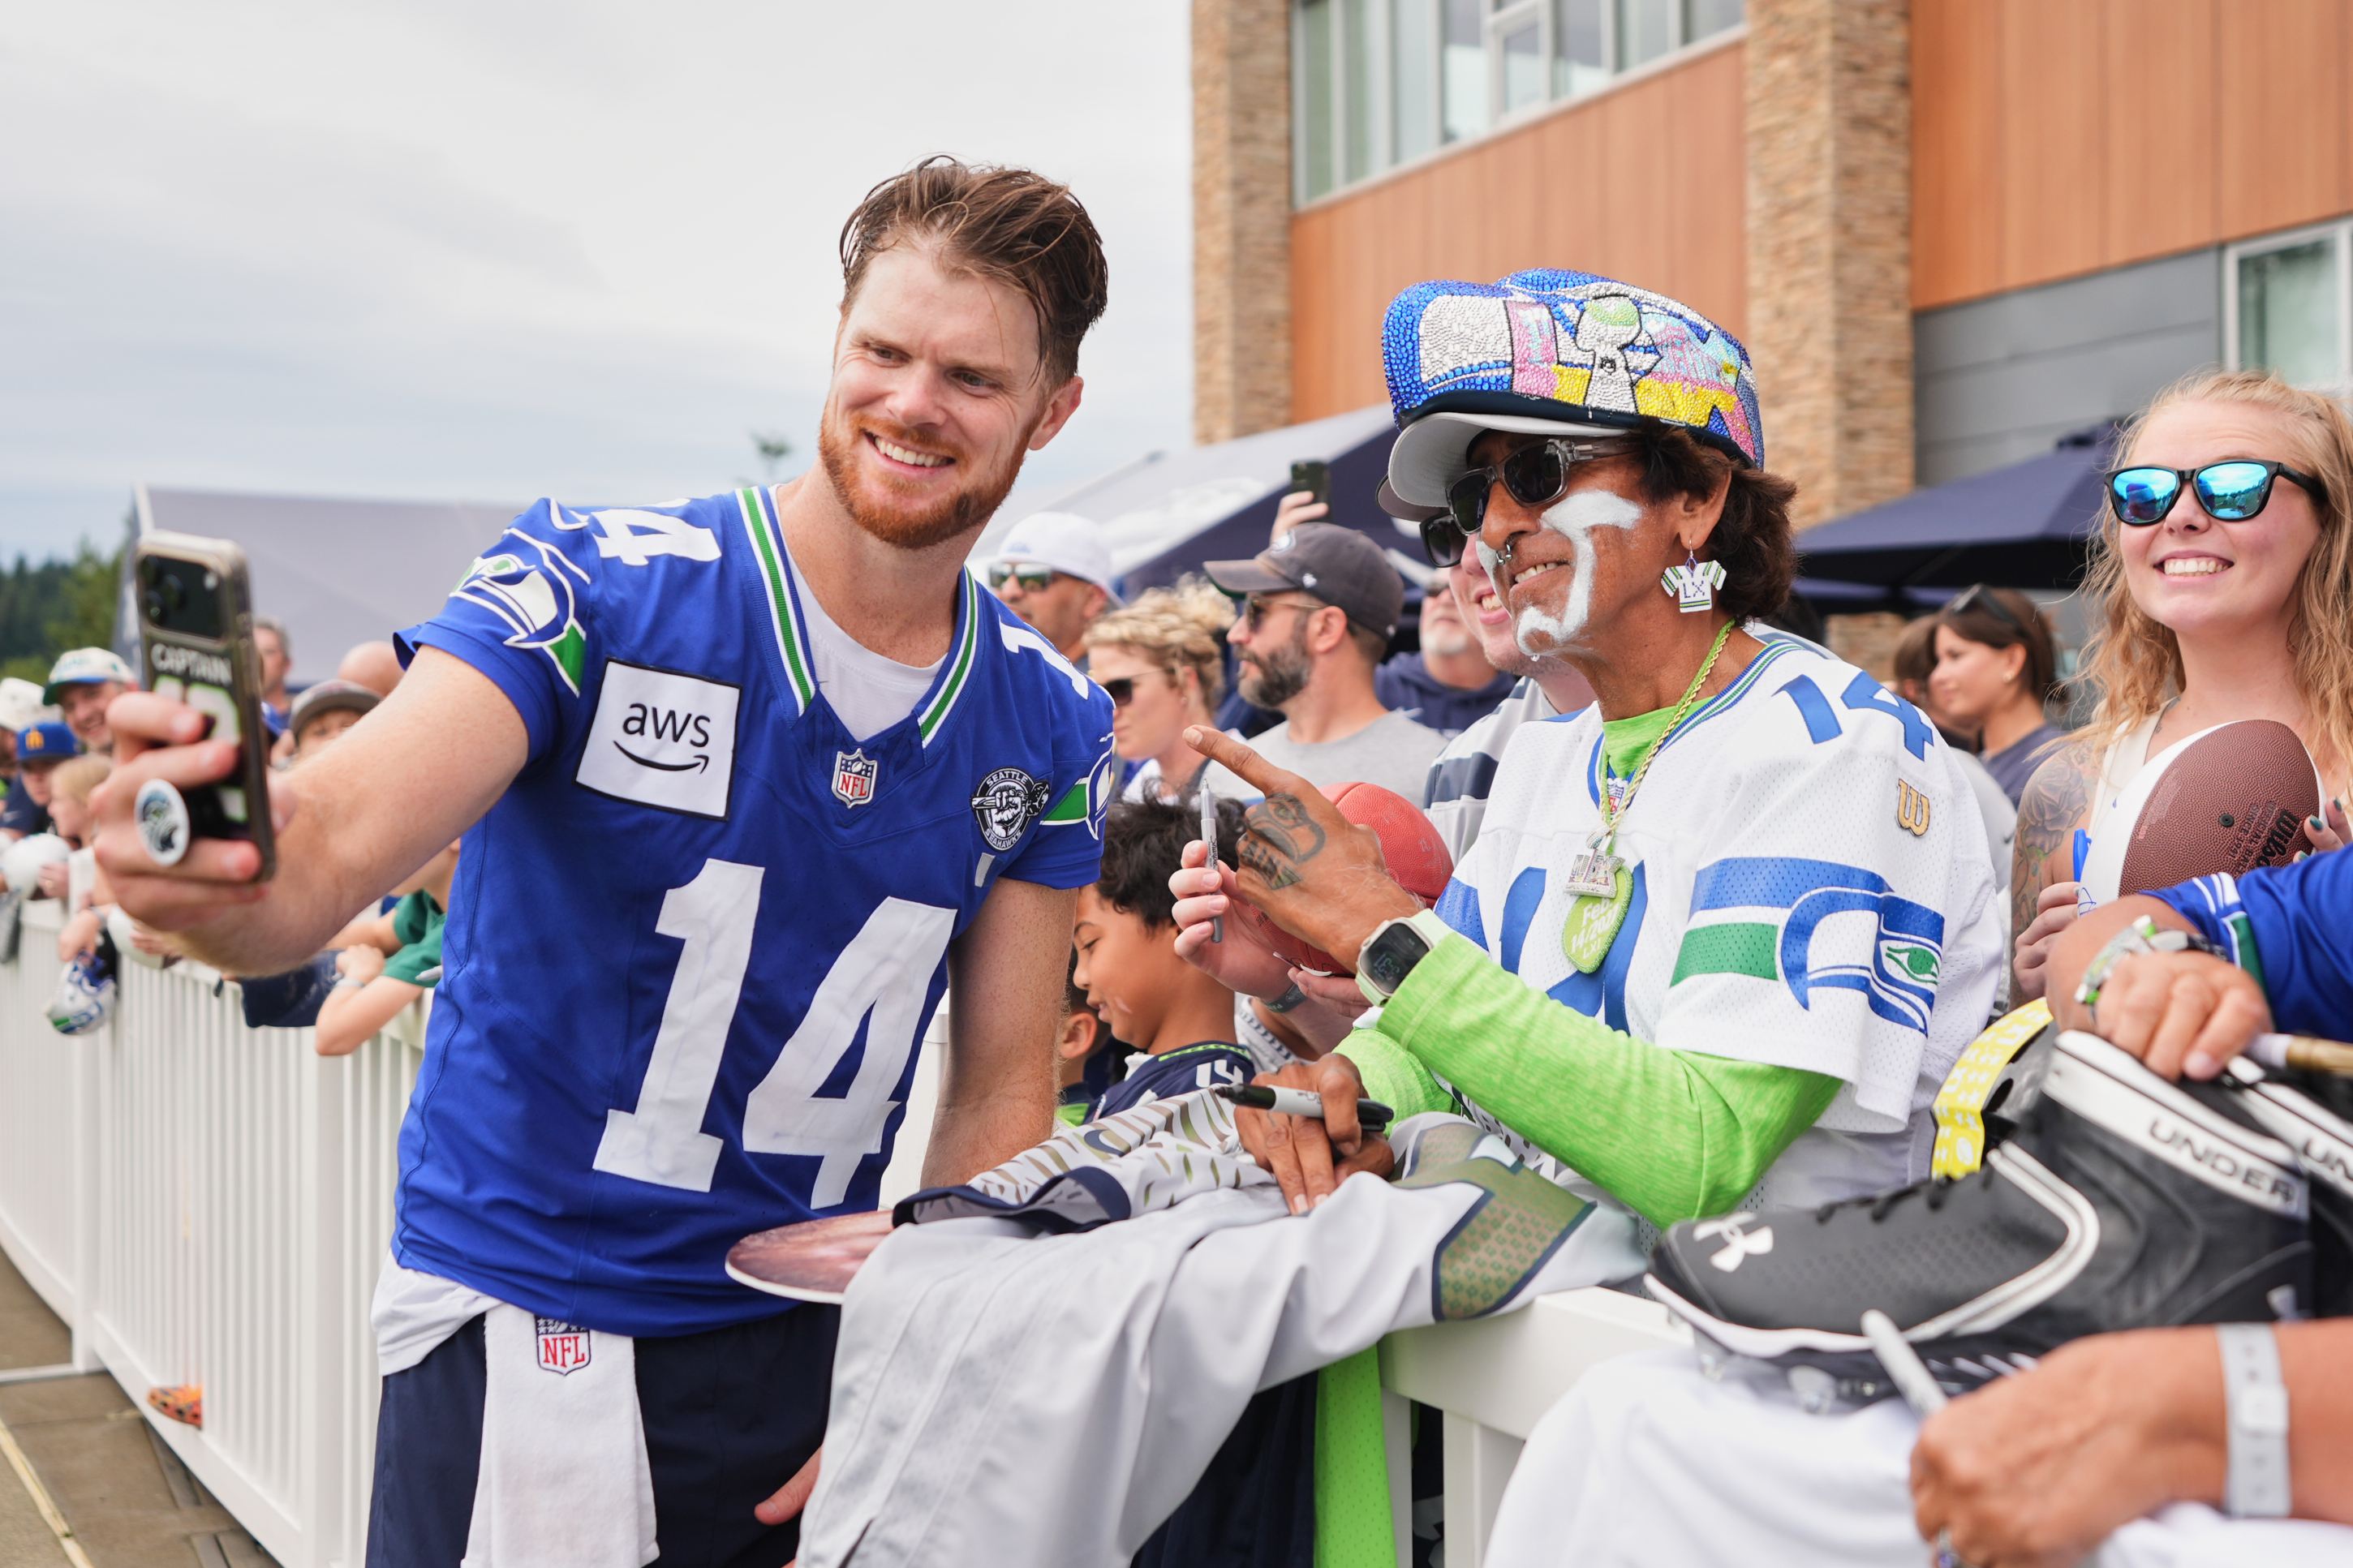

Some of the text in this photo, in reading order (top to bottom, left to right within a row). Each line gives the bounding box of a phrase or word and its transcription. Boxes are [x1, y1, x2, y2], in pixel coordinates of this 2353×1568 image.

[1683, 580, 1706, 599] LX
[622, 702, 711, 748] aws
[1771, 670, 1935, 763] 14
[840, 773, 867, 797] NFL
[986, 771, 1029, 787] SEATTLE
[2241, 804, 2261, 836] SINCE
[984, 828, 1022, 848] SEAHAWKS
[2256, 810, 2303, 867] Wilso
[2235, 848, 2253, 877] BALL
[1583, 938, 1602, 960] LXI
[592, 857, 958, 1210] 14
[2149, 1119, 2295, 1203] UNDER
[542, 1335, 585, 1368] NFL
